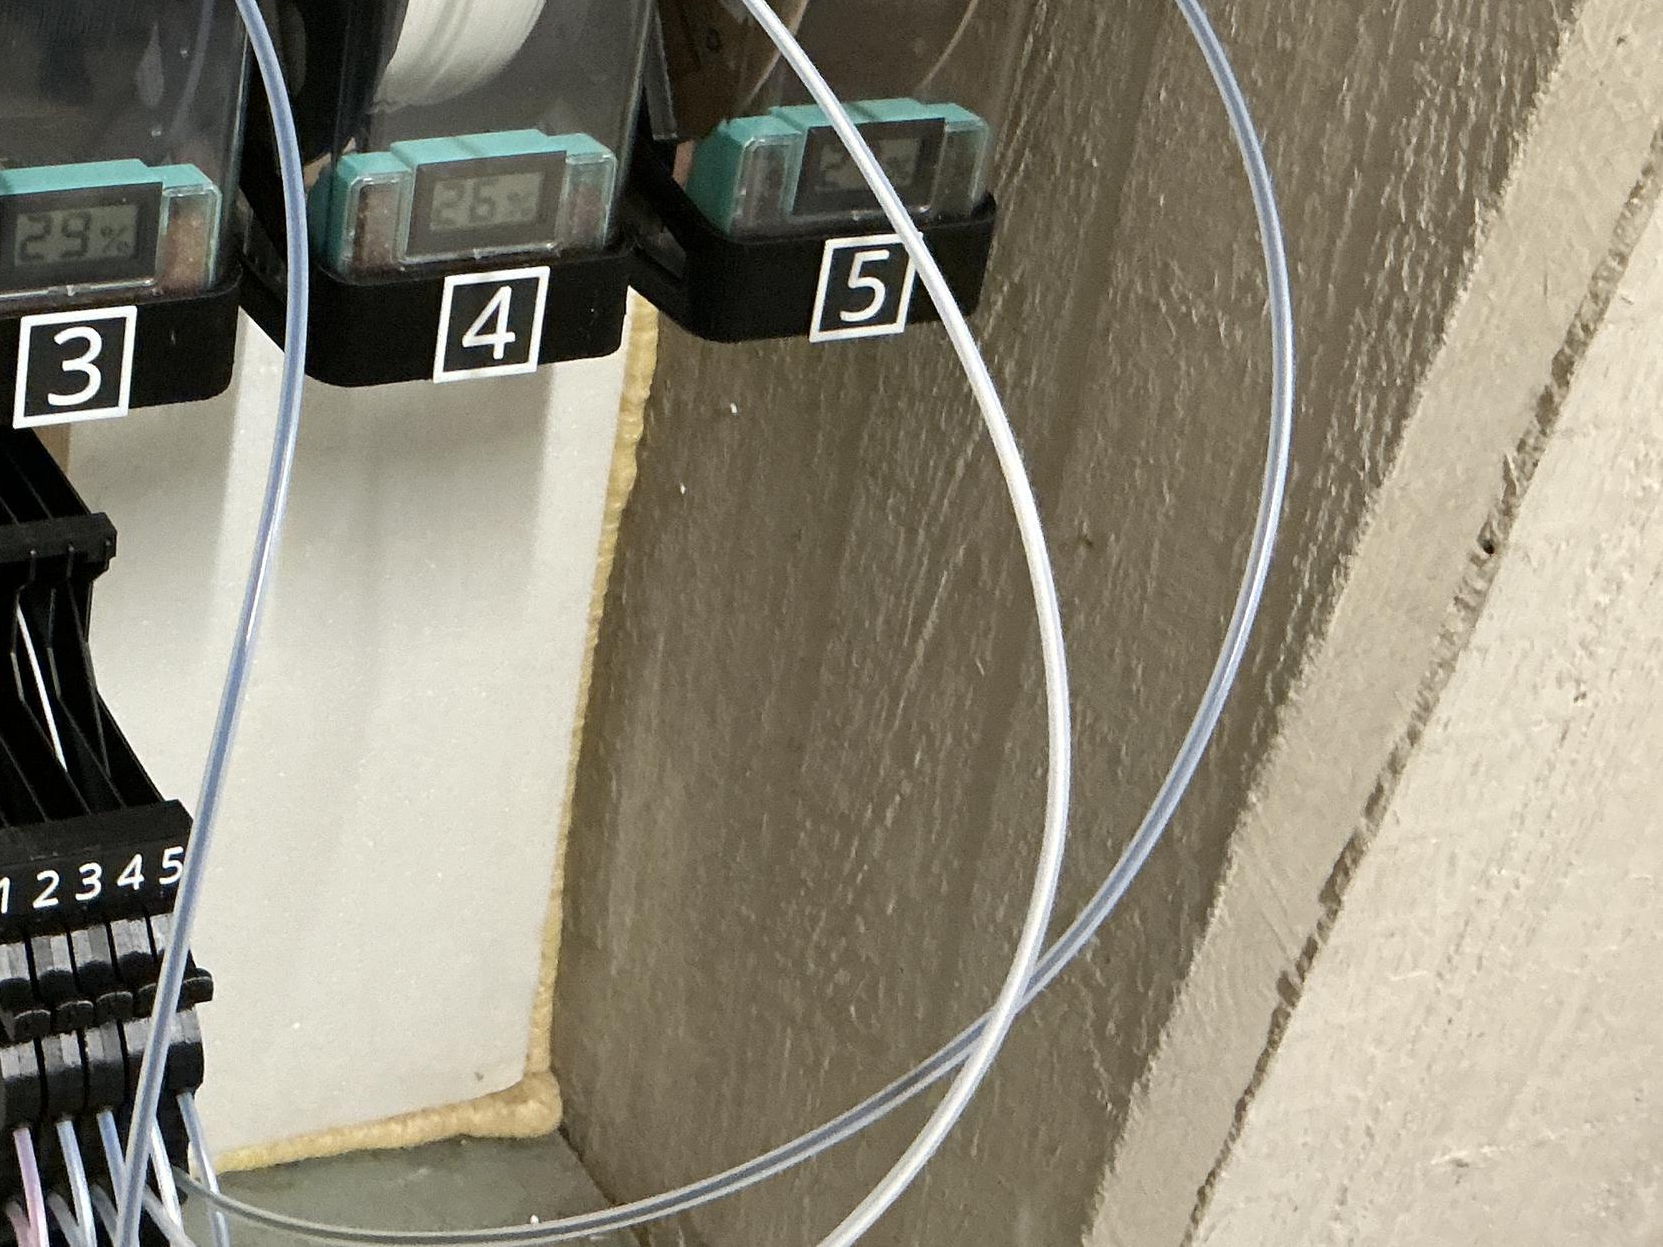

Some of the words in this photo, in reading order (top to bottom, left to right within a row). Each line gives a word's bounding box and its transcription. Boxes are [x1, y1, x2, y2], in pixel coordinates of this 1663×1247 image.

[20, 211, 132, 261] 29%
[840, 249, 890, 322] 5
[462, 286, 516, 360] 4
[47, 326, 103, 406] 3
[32, 870, 60, 909] 2
[75, 862, 103, 901] 3
[116, 854, 145, 891] 4
[158, 846, 184, 884] 5
